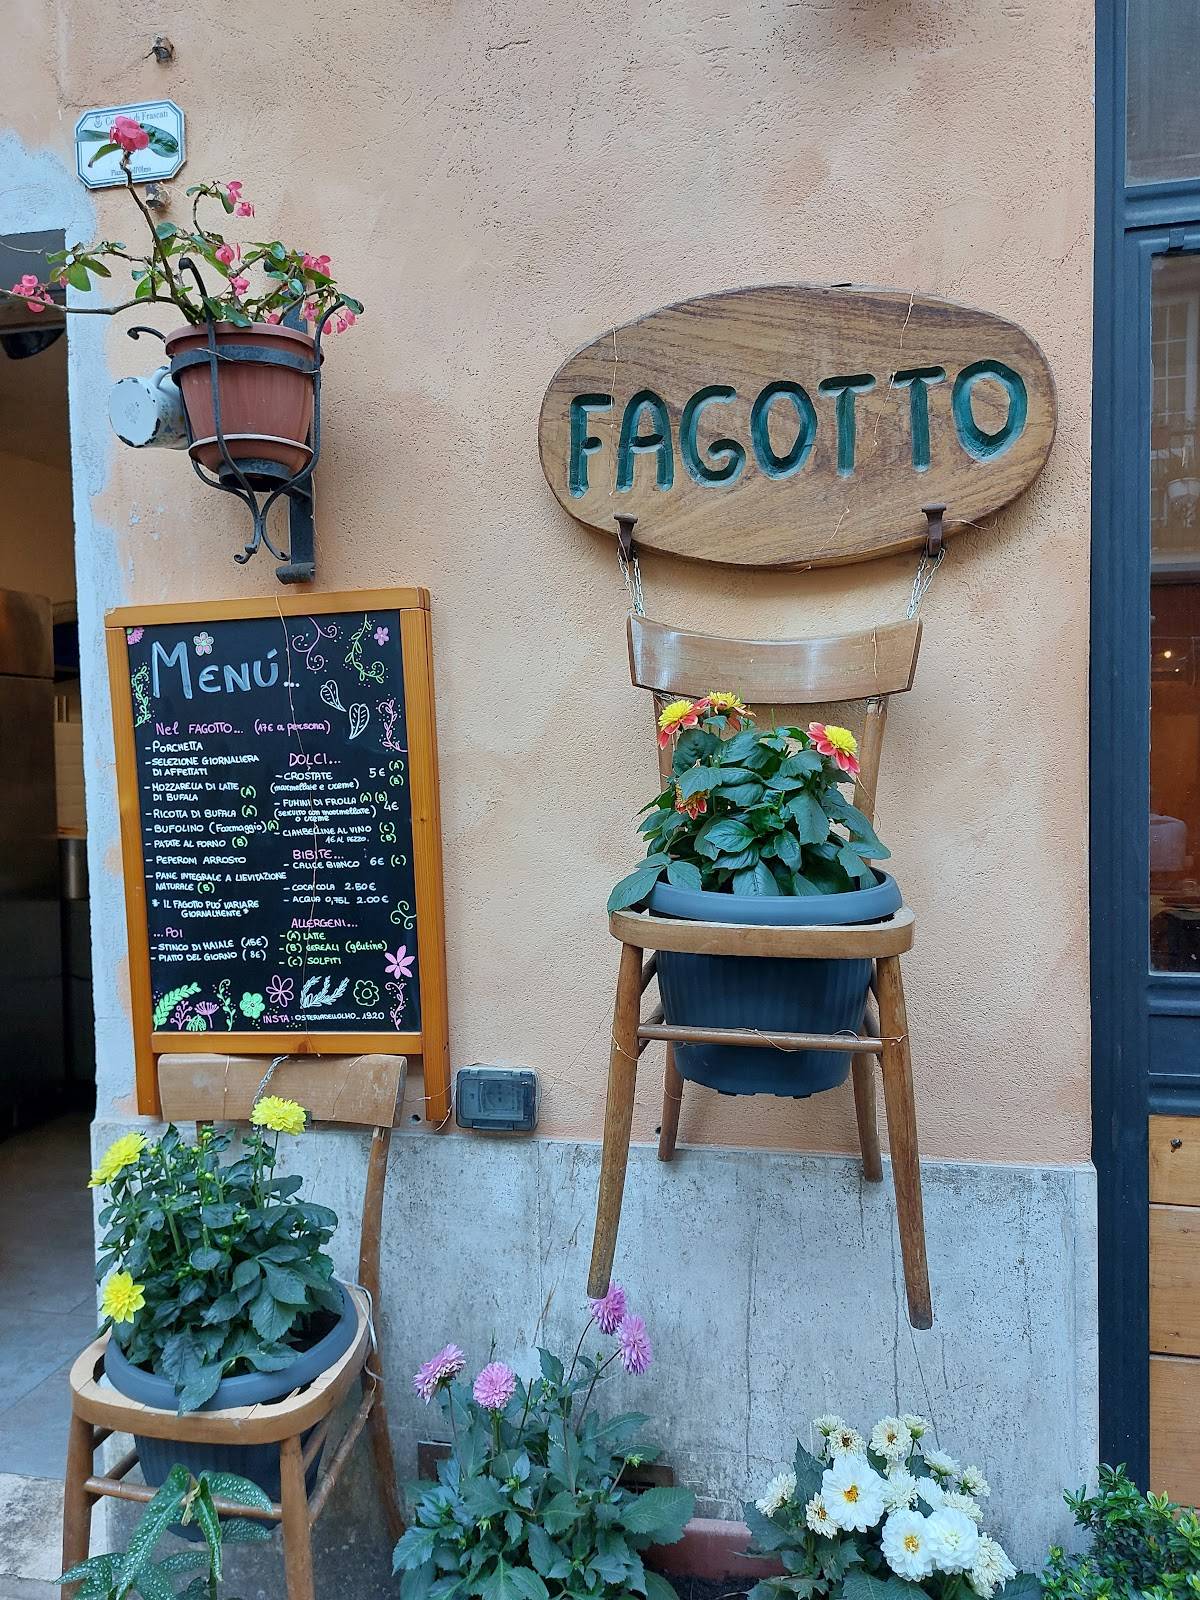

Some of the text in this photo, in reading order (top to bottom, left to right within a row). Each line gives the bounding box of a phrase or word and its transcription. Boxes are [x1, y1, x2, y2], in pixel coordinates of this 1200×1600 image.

[142, 110, 168, 121] Frascati
[568, 358, 1029, 500] FAGOTTO
[155, 721, 180, 736] Nel
[201, 754, 260, 766] GIORNALIERA
[388, 760, 404, 771] (A)
[152, 767, 208, 776] DI AFFETTATI
[389, 774, 404, 787] (B)
[205, 782, 216, 791] DI
[218, 782, 240, 791] LATTE
[153, 785, 257, 802] DI BUFALA (A)
[313, 798, 323, 806] DI
[324, 797, 357, 806] FROLLA
[359, 791, 372, 803] (A)
[374, 791, 388, 804] (B)
[191, 809, 201, 819] DI
[204, 808, 237, 819] BUFALA
[241, 804, 258, 818] (A)
[267, 819, 279, 832] (A)
[282, 826, 336, 837] CIAMBELLINE
[336, 827, 348, 835] AL
[348, 825, 372, 834] VINO
[154, 835, 248, 849] PATATE AL FORNO (B)
[336, 835, 345, 843] AL
[155, 855, 247, 865] PEPERONI ARROSTO
[292, 861, 325, 869] CALICE
[326, 860, 360, 869] BIANCO
[155, 871, 287, 882] PANE INTEGRALE A LIEVITAZIONE
[155, 881, 215, 895] NATURALE (B)
[315, 882, 336, 891] COLA
[163, 899, 172, 909] IL
[173, 900, 204, 910] FAGOTTO
[223, 899, 260, 910] VARIARE
[292, 895, 321, 903] ACQUA
[303, 932, 327, 940] LATTE
[191, 943, 202, 952] DI
[202, 939, 235, 950] MAIALE
[305, 943, 340, 952] CEREALI
[345, 939, 388, 954] (glutine)
[158, 953, 184, 962] PIATTO
[186, 953, 202, 962] DEL
[203, 951, 238, 961] GIORNO
